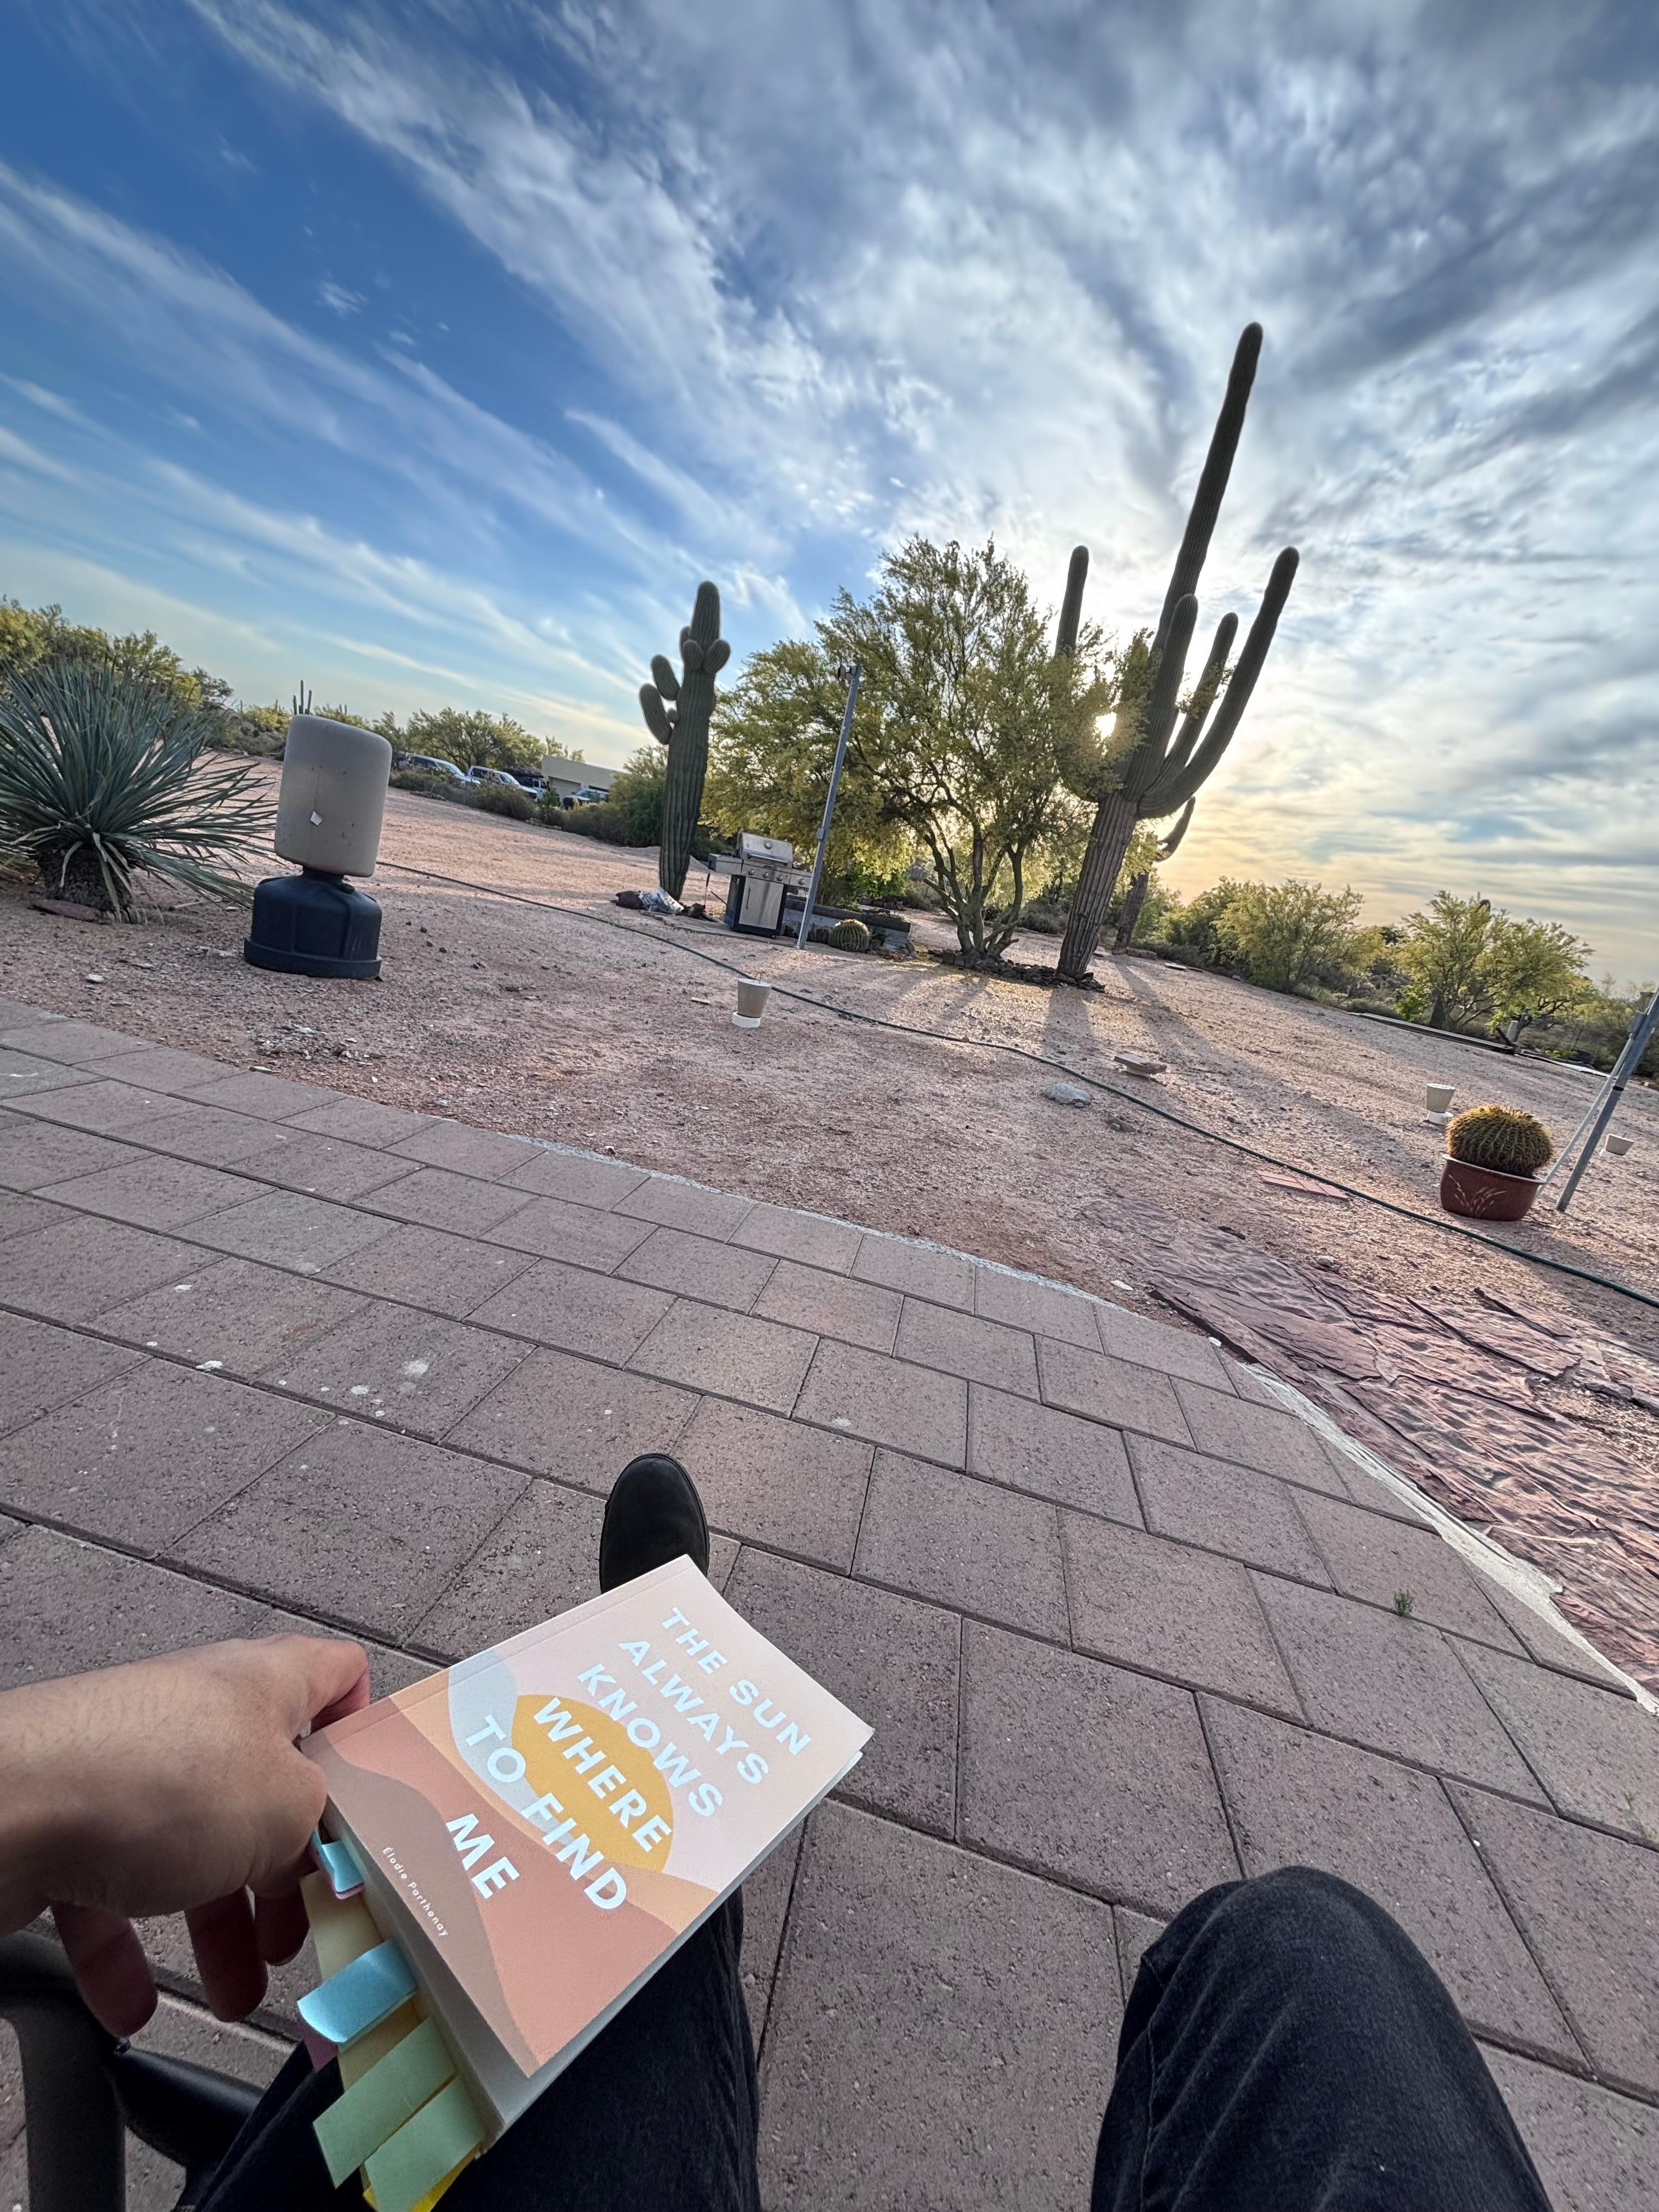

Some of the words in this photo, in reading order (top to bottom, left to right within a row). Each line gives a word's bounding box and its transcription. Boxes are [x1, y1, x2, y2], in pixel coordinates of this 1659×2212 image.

[578, 1664, 723, 1816] KNOWS
[619, 1640, 769, 1784] ALWAYS
[662, 1607, 727, 1674] THE
[730, 1679, 811, 1755] SUN
[466, 1716, 526, 1782] TO
[522, 1792, 627, 1910] FIND
[534, 1697, 672, 1853] WHERE
[382, 1847, 407, 1879] Élodie
[408, 1882, 448, 1936] Parthenay
[446, 1813, 520, 1899] ME
